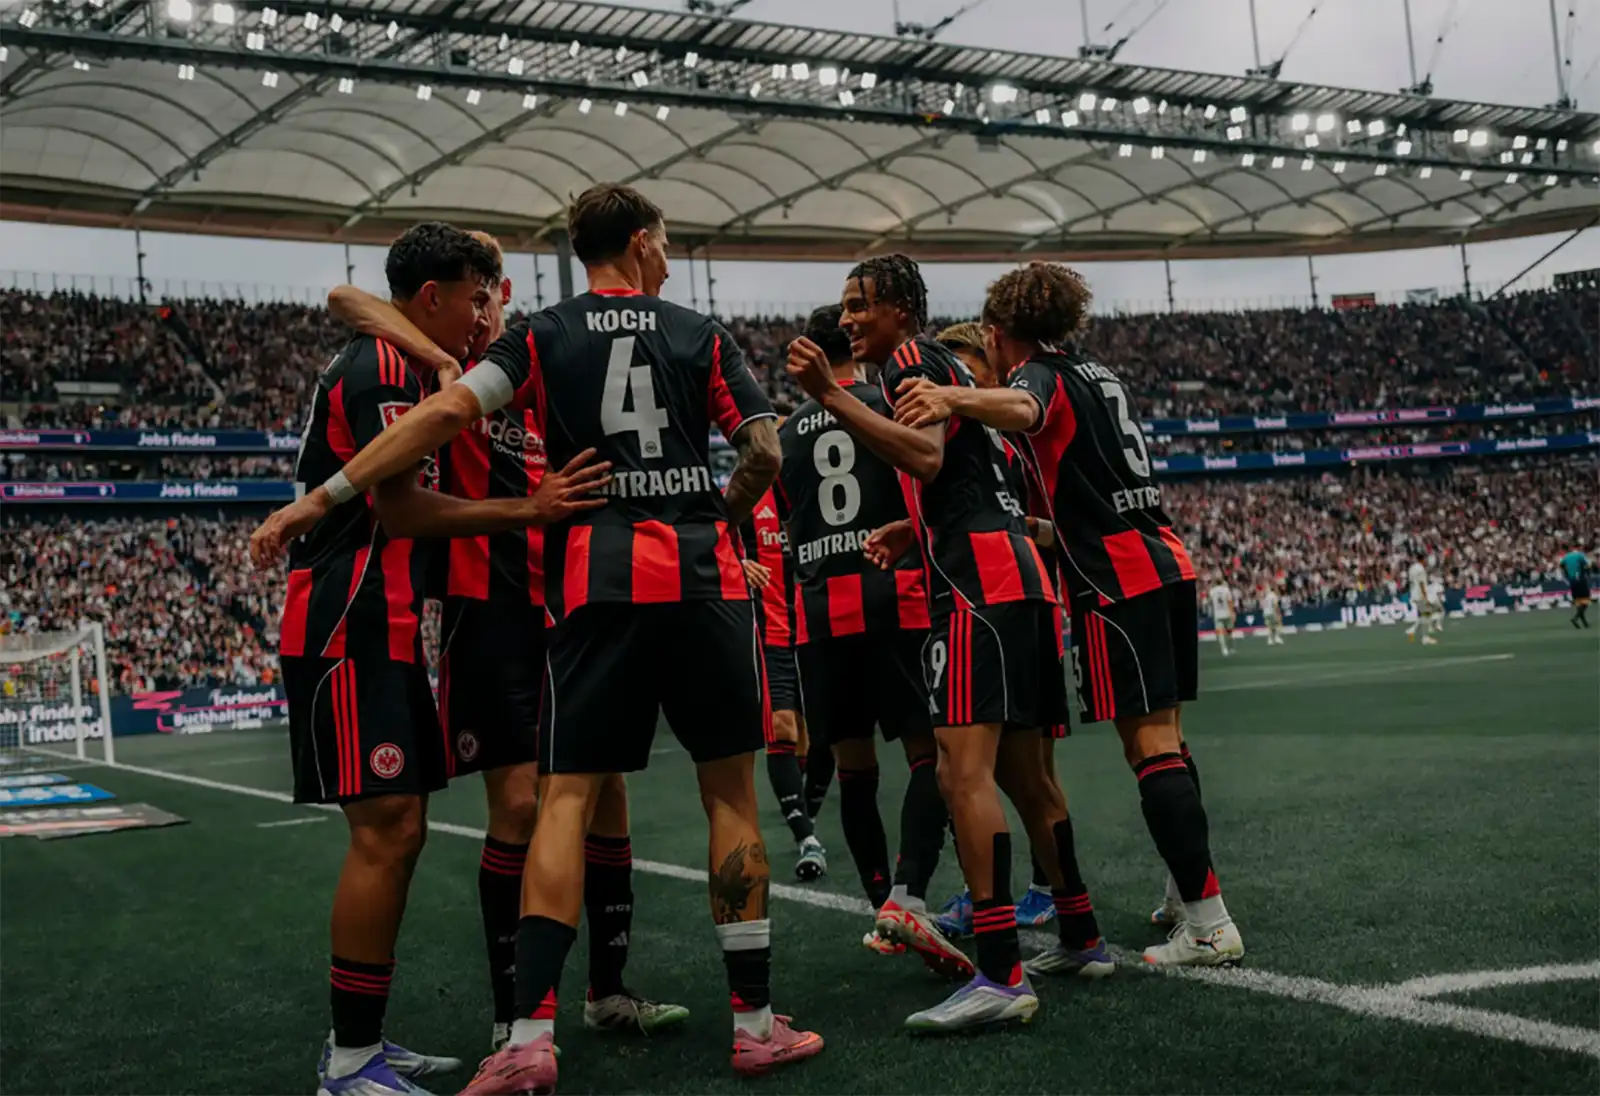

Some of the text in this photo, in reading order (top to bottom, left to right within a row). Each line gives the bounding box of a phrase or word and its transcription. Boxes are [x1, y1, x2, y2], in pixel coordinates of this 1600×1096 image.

[586, 309, 656, 332] KOCH
[601, 335, 669, 458] 4
[138, 432, 169, 446] Jobs
[171, 432, 217, 446] finden
[1100, 381, 1150, 478] 3
[160, 483, 191, 497] Jobs
[194, 483, 239, 497] finden
[813, 429, 861, 526] 8
[931, 640, 947, 689] 9
